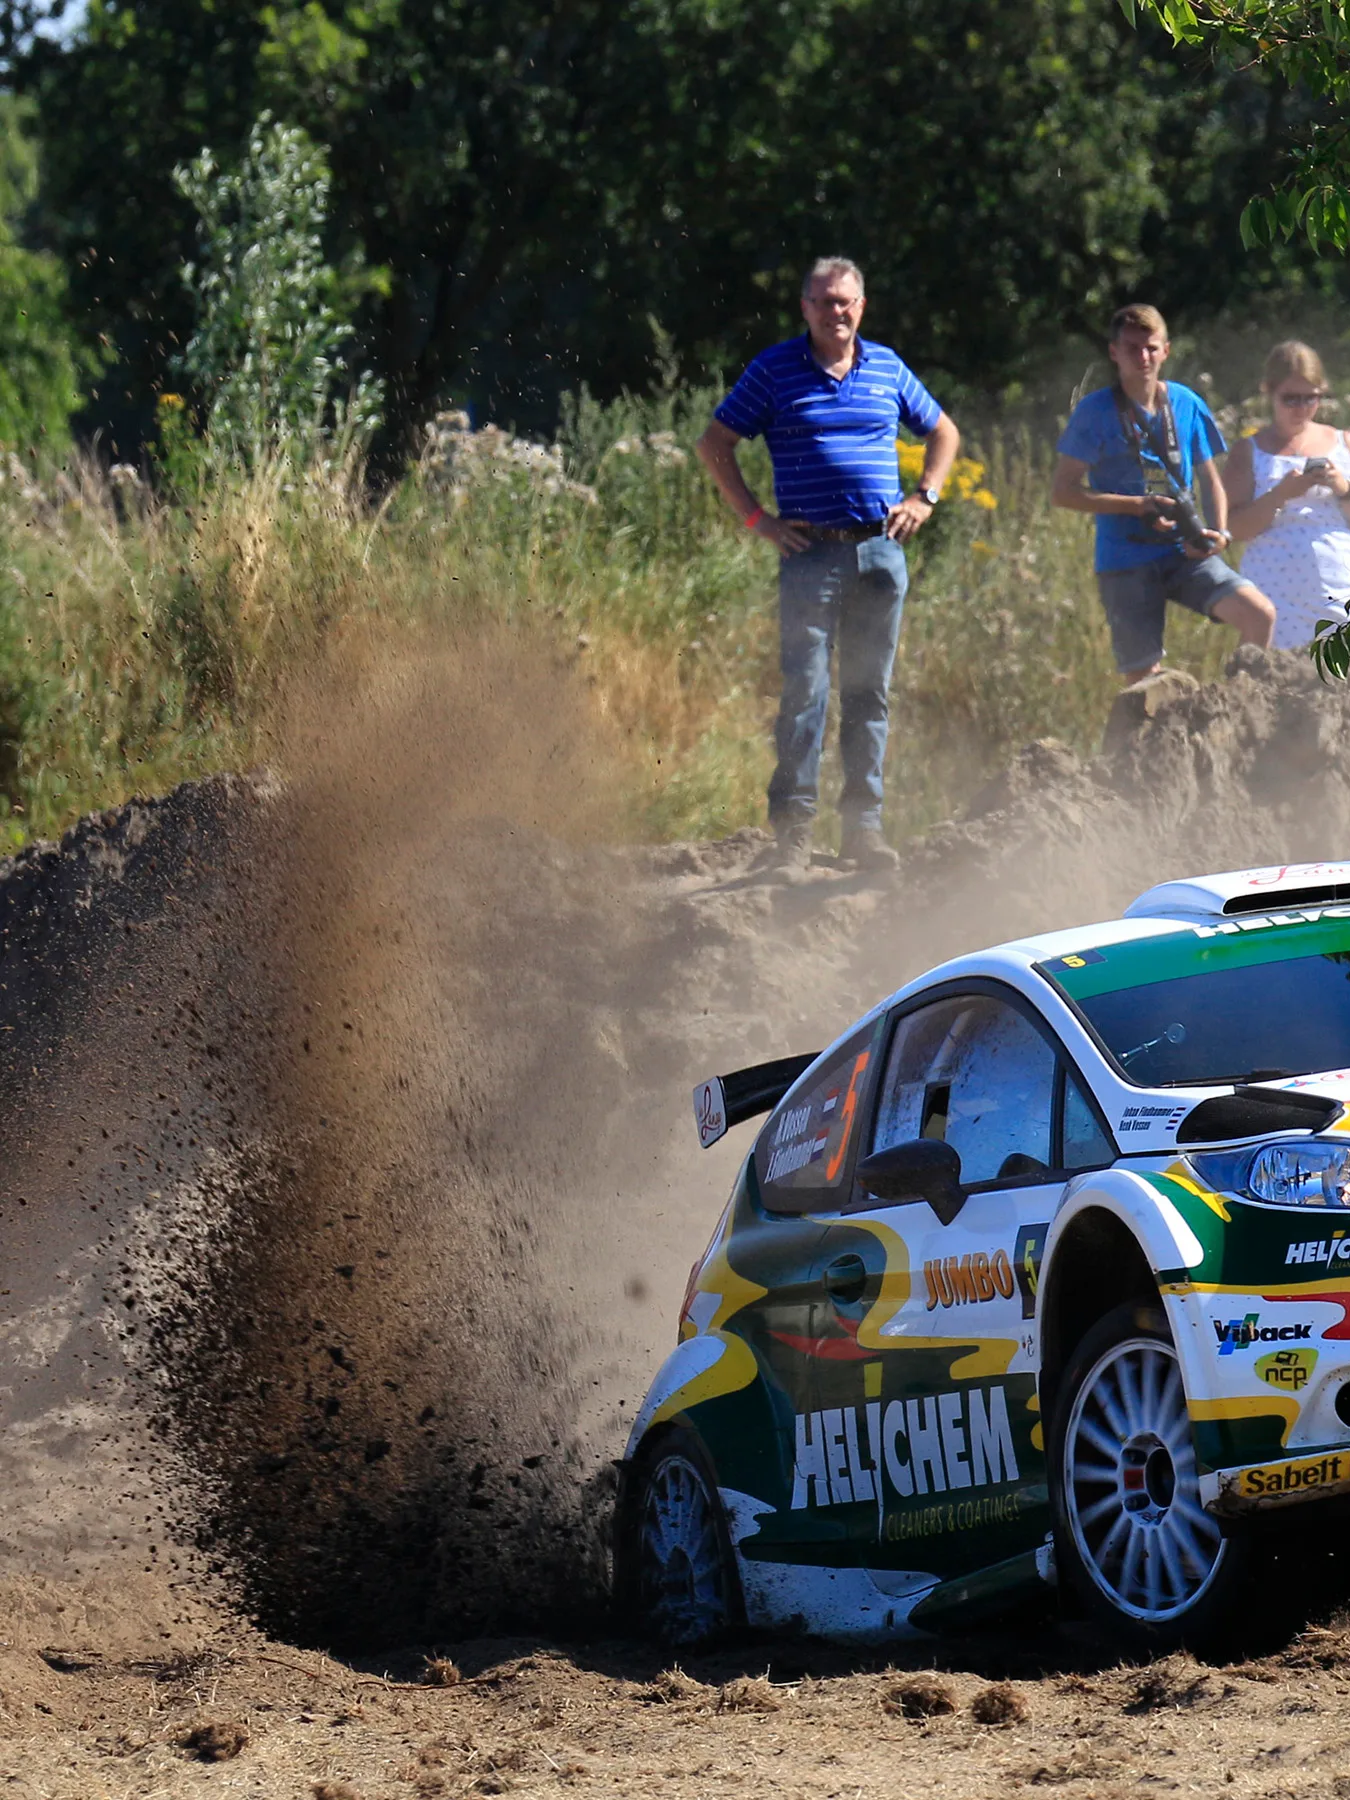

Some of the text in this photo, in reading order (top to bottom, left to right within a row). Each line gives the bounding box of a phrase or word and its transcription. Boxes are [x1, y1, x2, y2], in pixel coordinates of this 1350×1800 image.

[1060, 954, 1087, 968] 5
[826, 1051, 870, 1181] 5
[924, 1248, 1014, 1311] JUMBO
[1023, 1239, 1038, 1297] 5
[1213, 1319, 1312, 1344] Vipack
[1265, 1367, 1307, 1390] ncp
[791, 1366, 1019, 1538] HELICHEM
[1246, 1456, 1342, 1495] Sabelt
[886, 1493, 1021, 1541] CLEANERS & COATINGS
